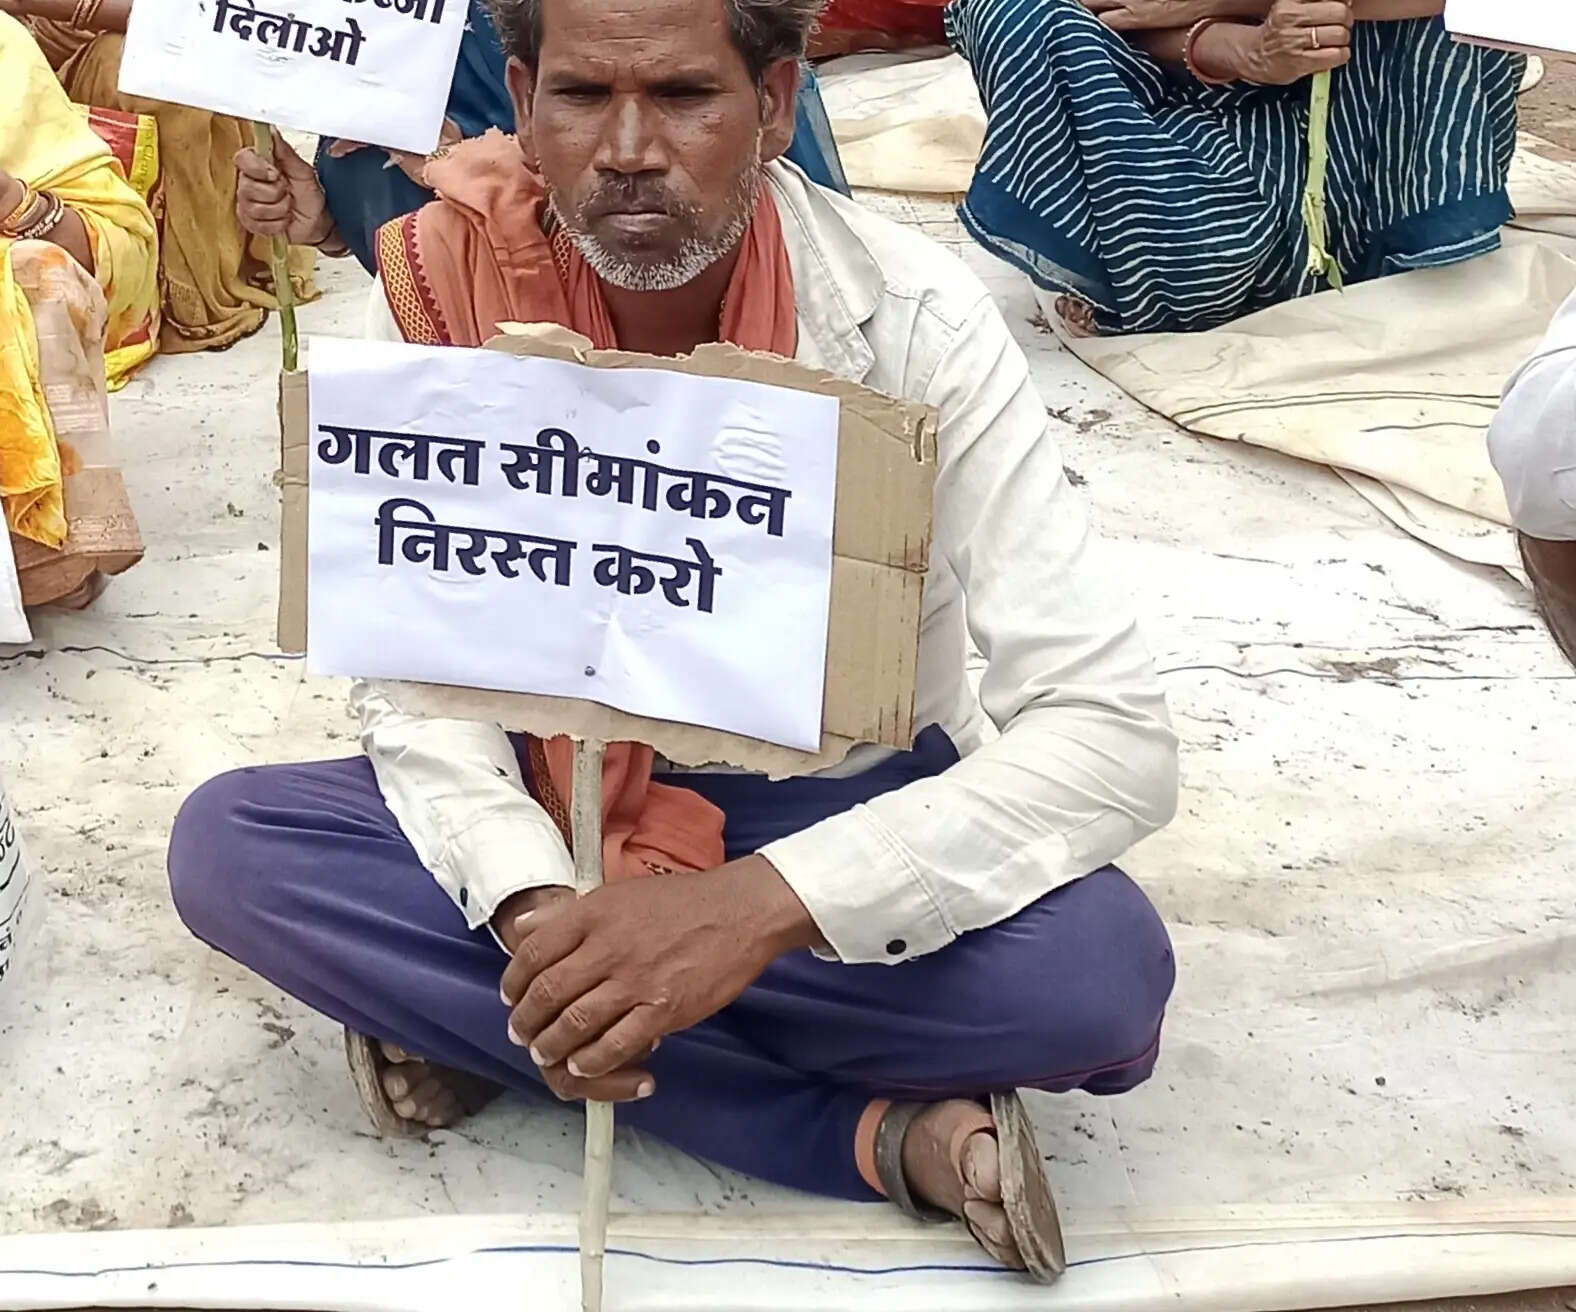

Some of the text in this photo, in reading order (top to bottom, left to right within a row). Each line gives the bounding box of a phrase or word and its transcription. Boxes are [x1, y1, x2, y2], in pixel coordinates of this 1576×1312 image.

[317, 424, 792, 537] गलत सीमांकन
[374, 497, 723, 614] निरस्त करो
